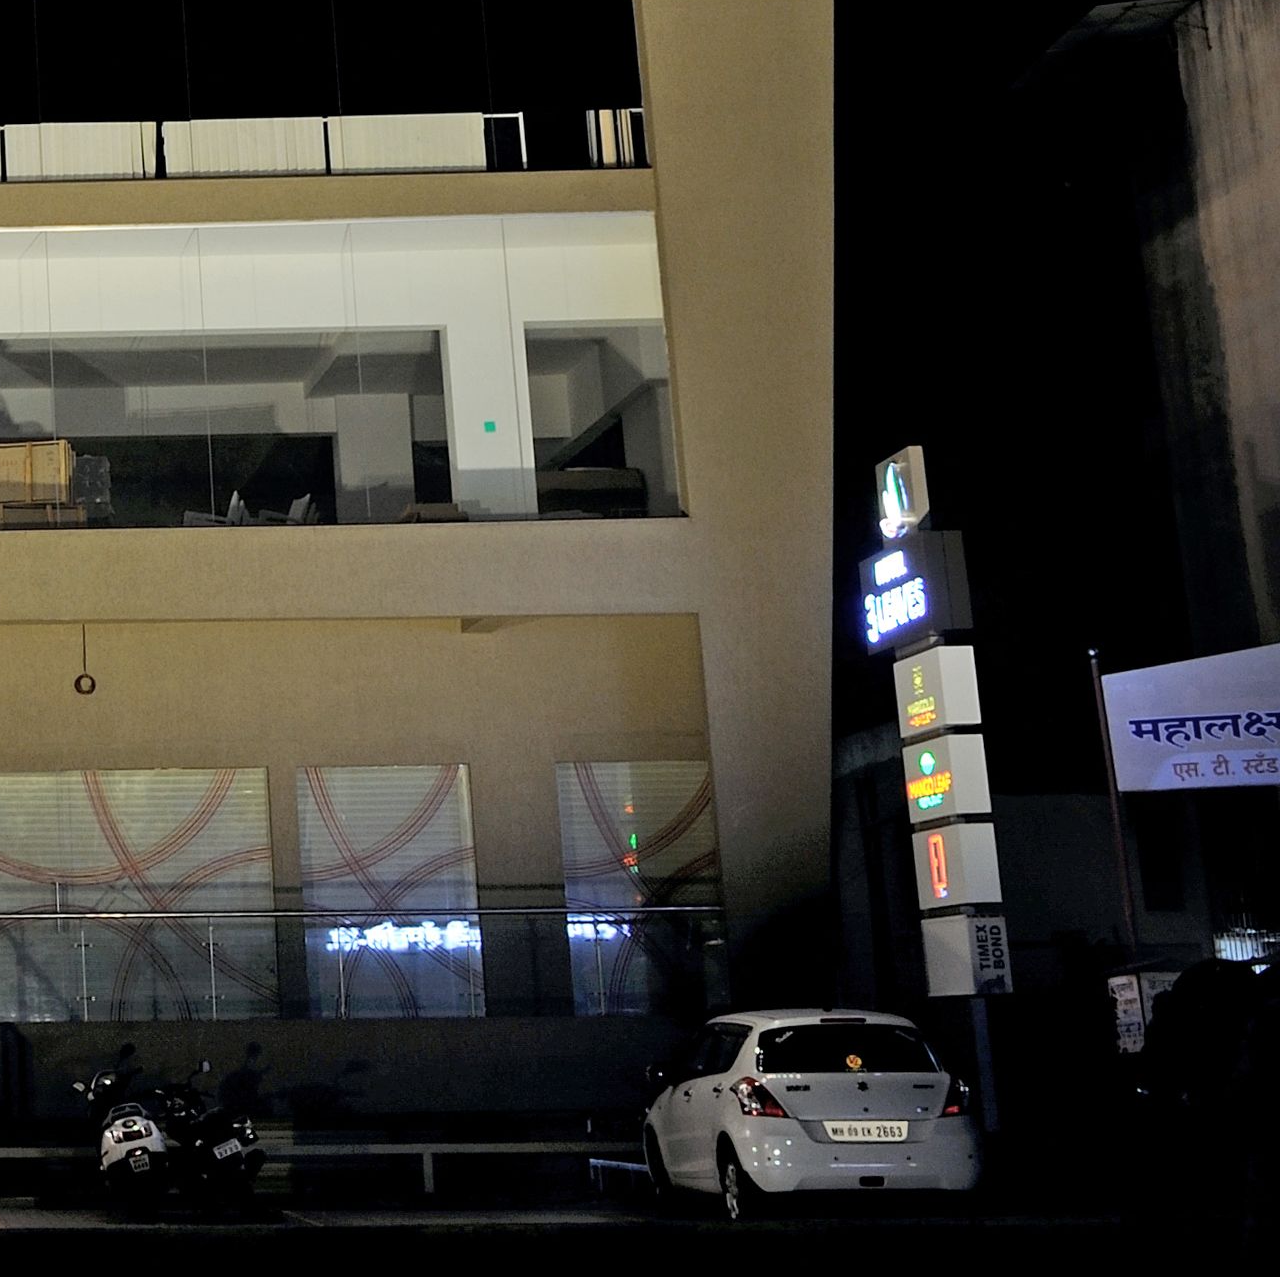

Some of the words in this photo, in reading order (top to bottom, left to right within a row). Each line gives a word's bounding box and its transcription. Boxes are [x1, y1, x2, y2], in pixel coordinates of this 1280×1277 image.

[975, 924, 991, 971] TIMEX
[989, 925, 1005, 969] BOND
[876, 1126, 903, 1138] 2663
